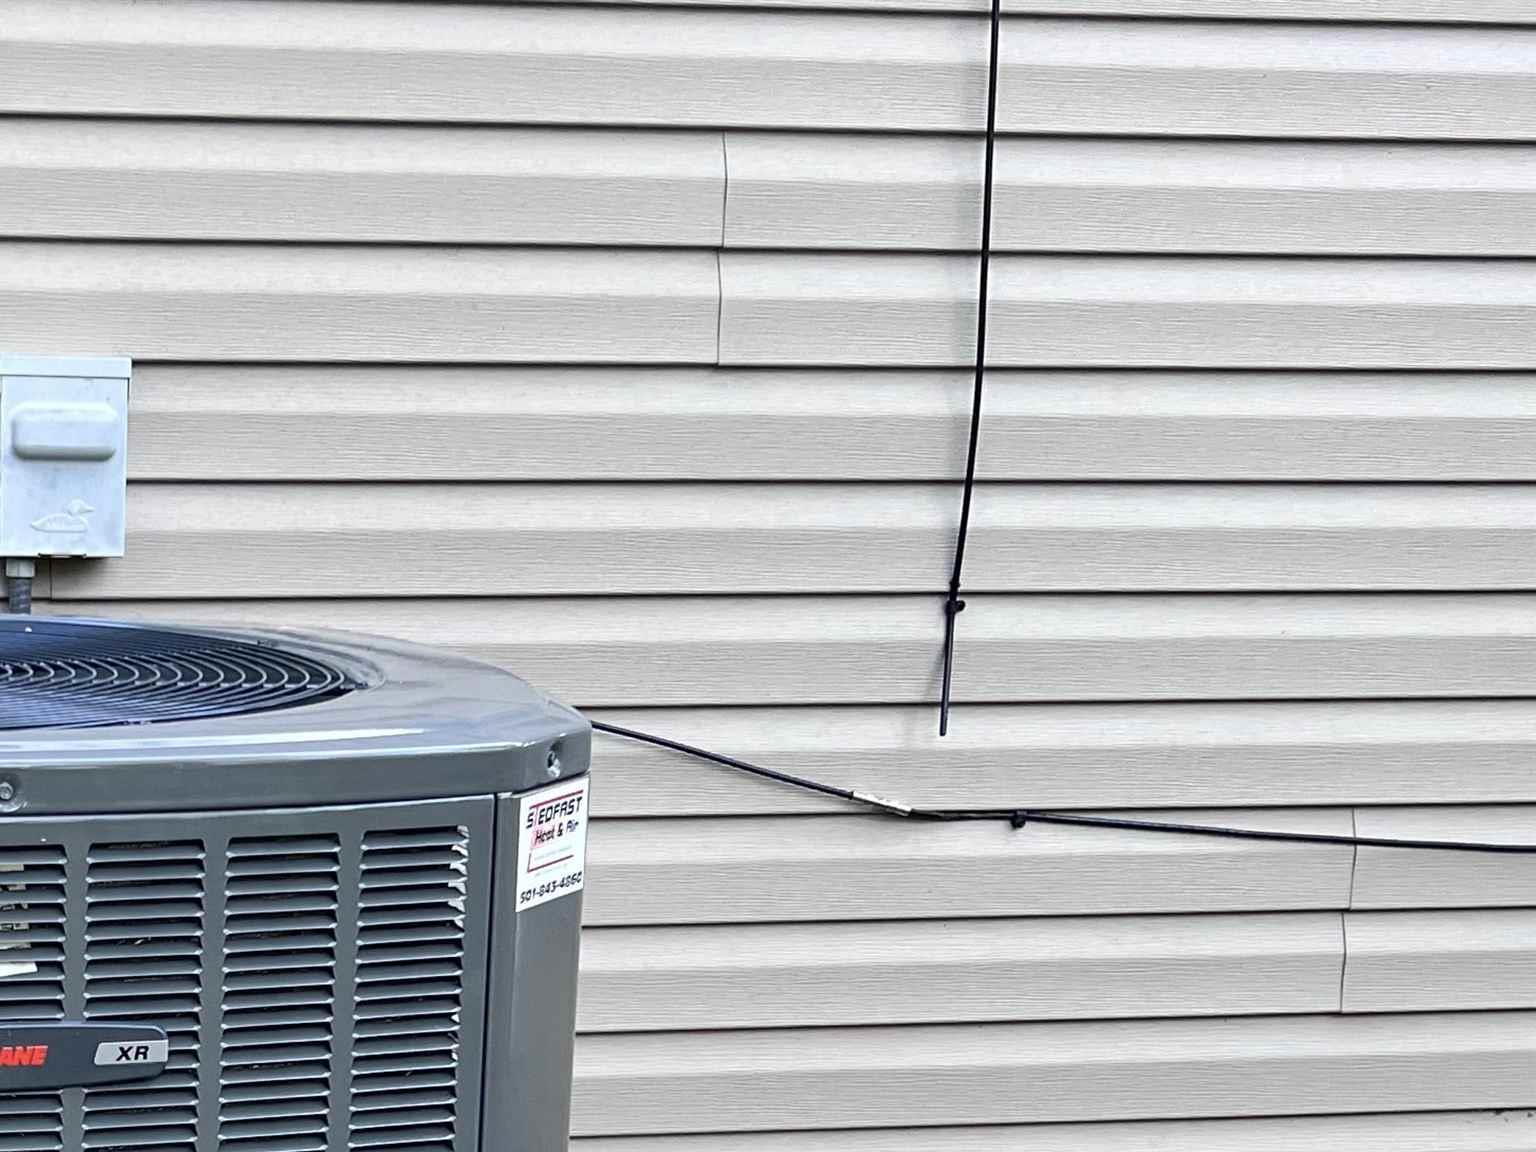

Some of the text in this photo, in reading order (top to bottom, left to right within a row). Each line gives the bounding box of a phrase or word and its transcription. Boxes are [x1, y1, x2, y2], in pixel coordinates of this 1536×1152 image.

[534, 819, 579, 845] Heat & Air
[116, 1045, 149, 1062] XR
